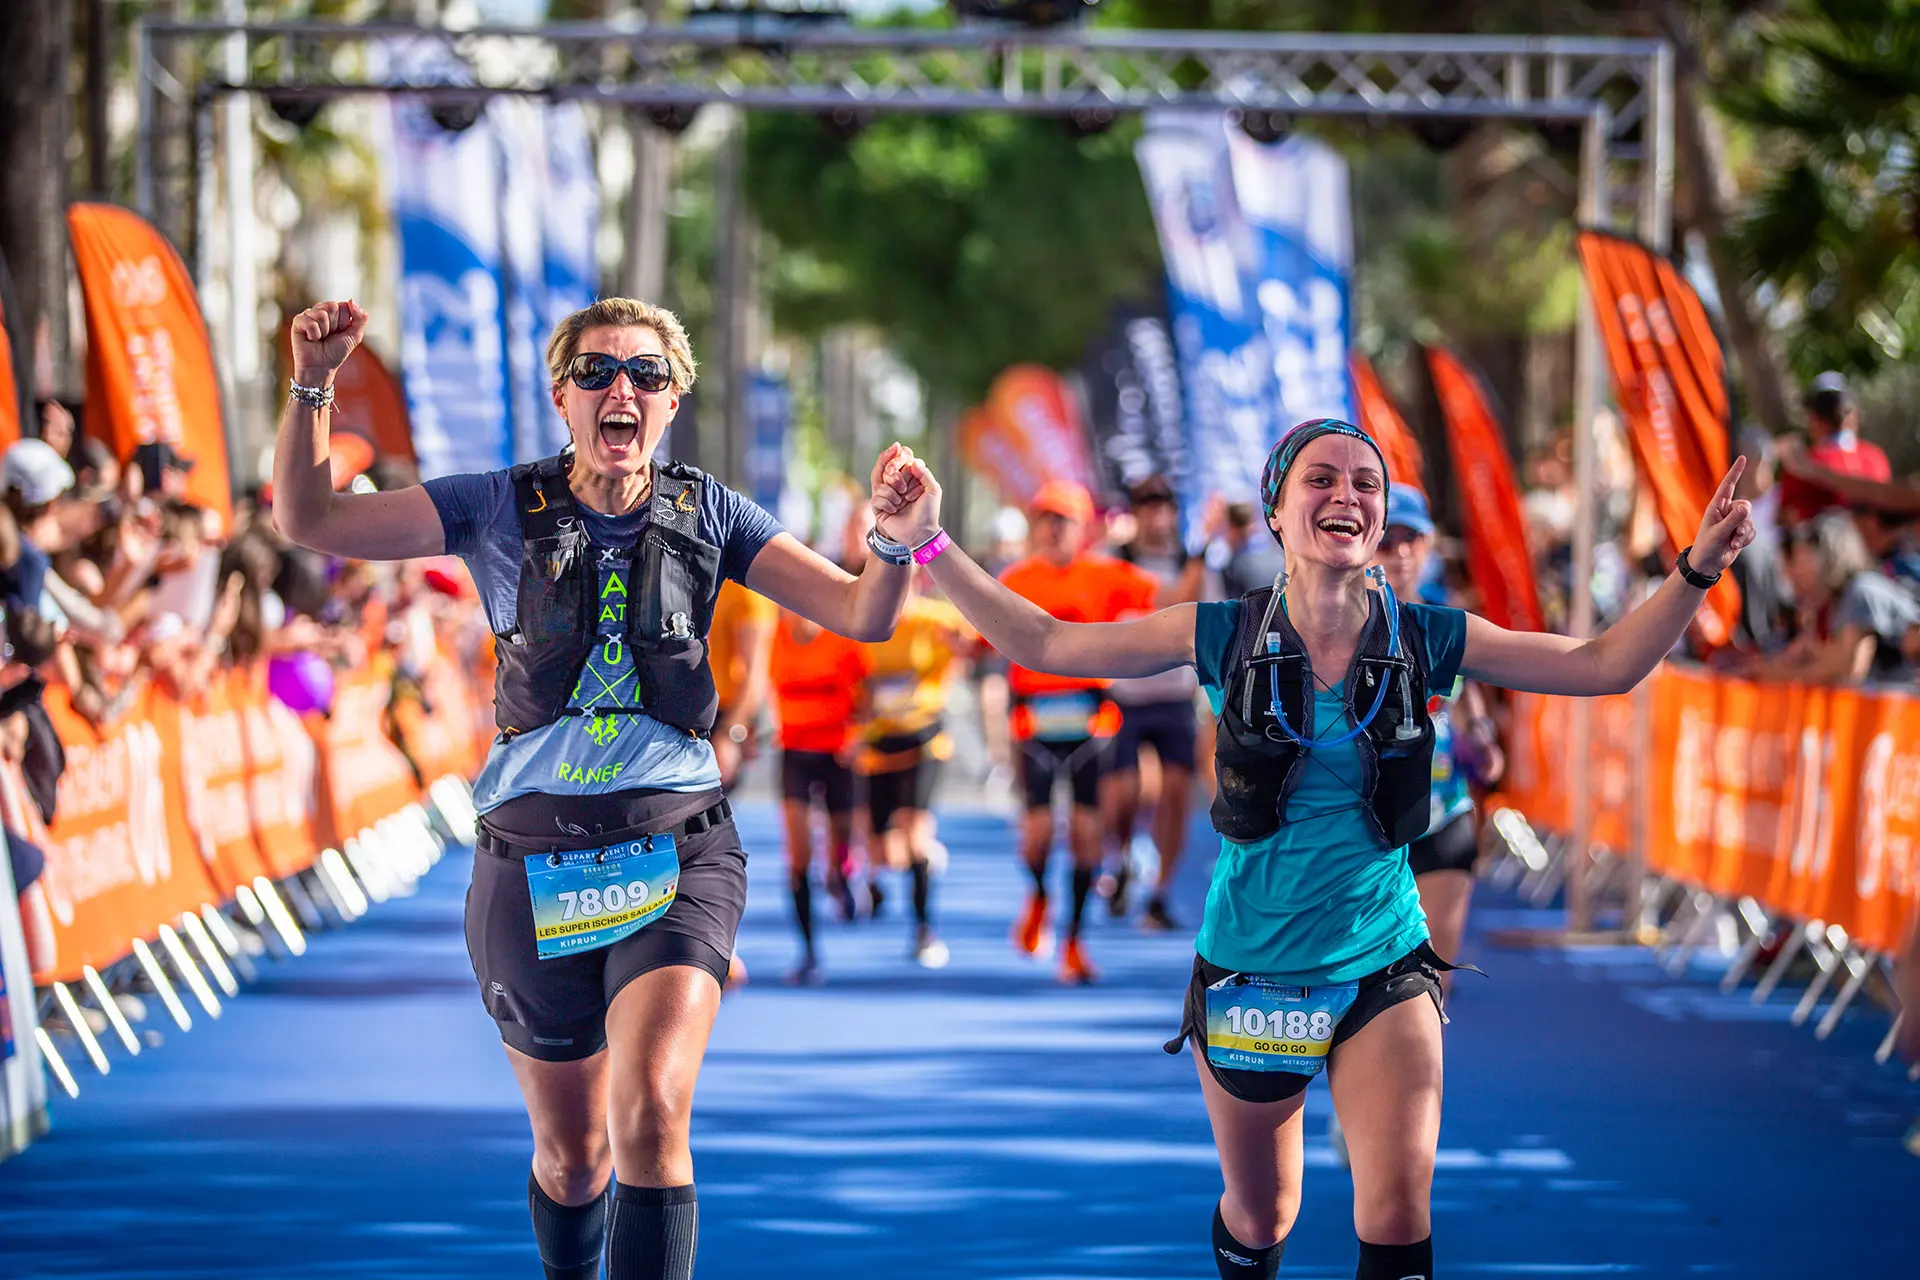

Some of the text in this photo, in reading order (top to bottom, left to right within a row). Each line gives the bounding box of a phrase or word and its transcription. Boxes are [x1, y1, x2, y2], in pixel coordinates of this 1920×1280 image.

[600, 571, 627, 599] A
[599, 604, 627, 623] AT
[562, 846, 625, 860] DÉPARTMENT
[558, 880, 649, 921] 7809
[539, 927, 557, 937] LES
[559, 921, 591, 934] SUPER
[592, 913, 629, 928] ISCHIOS
[560, 935, 597, 948] KIPRUN
[1224, 1005, 1333, 1042] 10188
[1254, 1041, 1307, 1054] GO GO GO
[1229, 1053, 1264, 1065] KIPRUN
